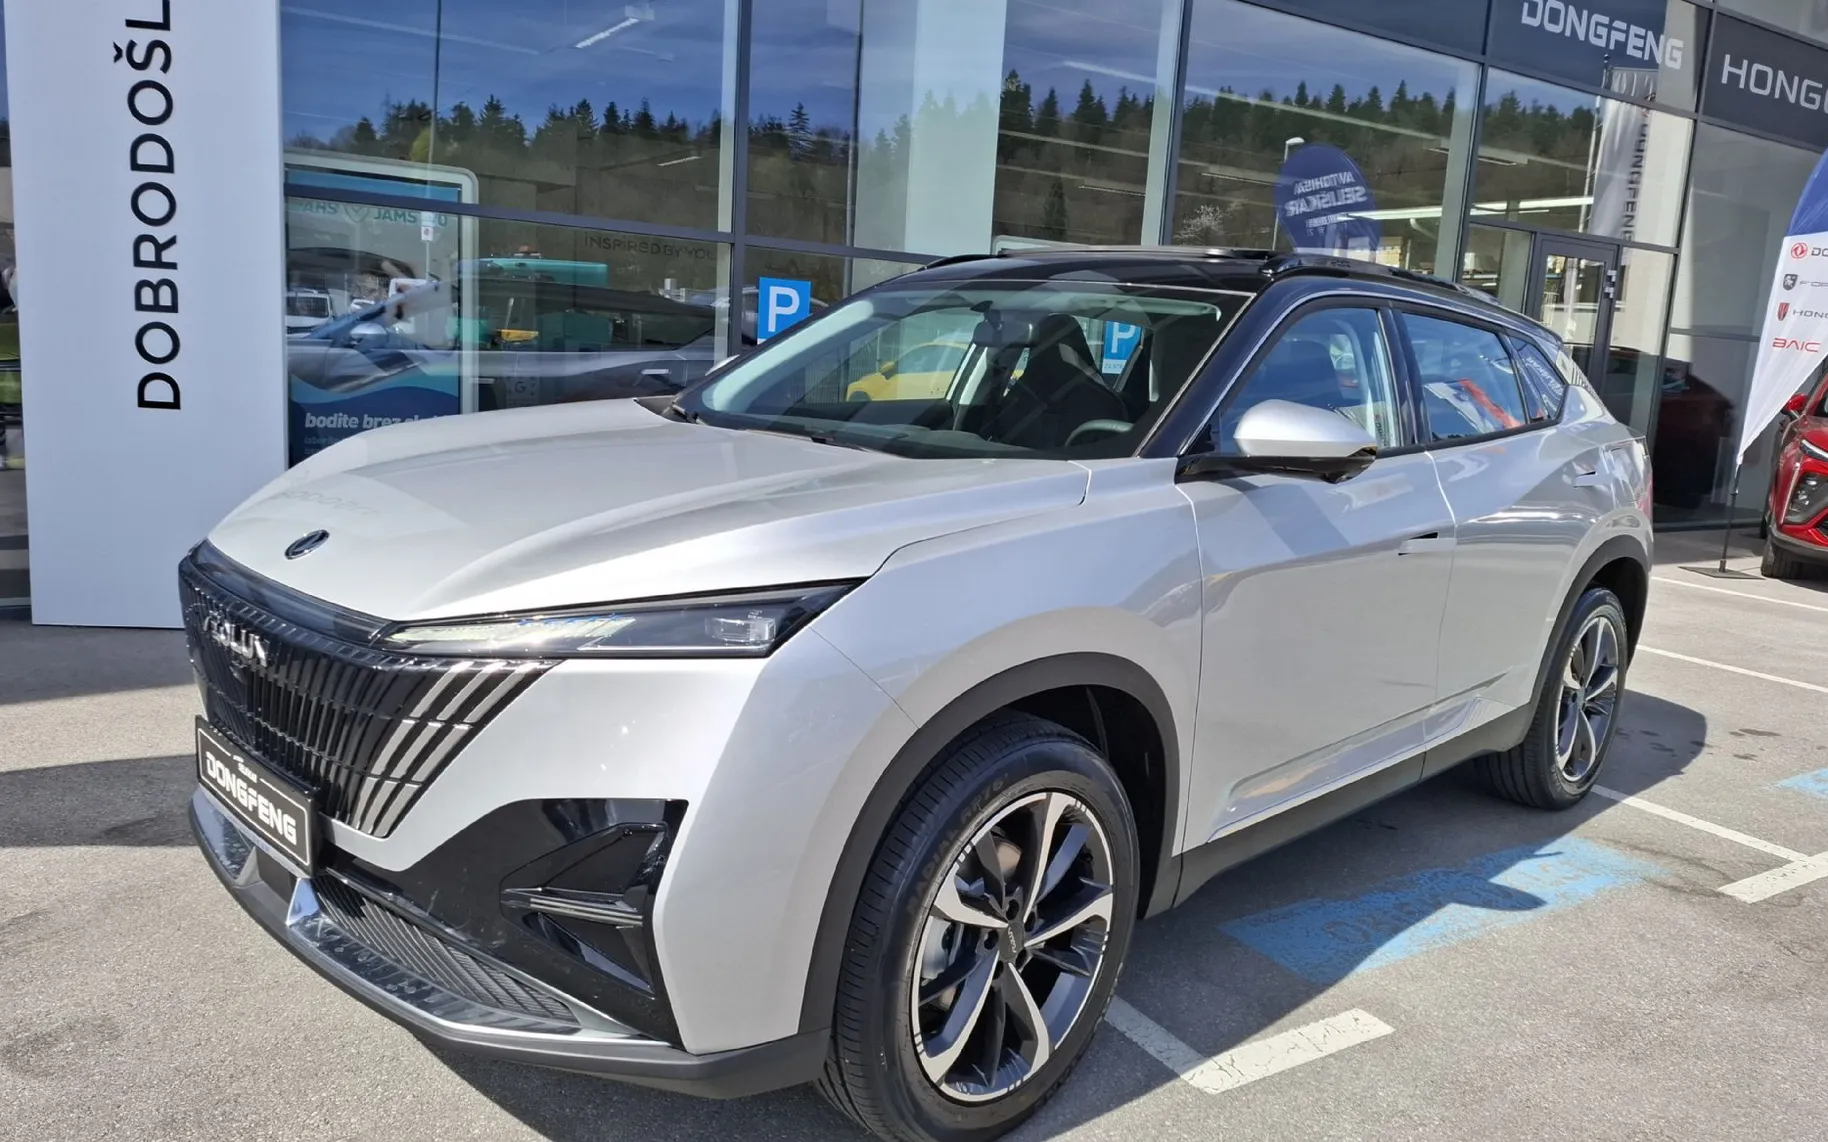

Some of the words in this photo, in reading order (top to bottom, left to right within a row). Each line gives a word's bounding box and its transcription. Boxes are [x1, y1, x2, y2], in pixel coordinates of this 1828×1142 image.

[1521, 0, 1684, 70] DONGFENG
[1721, 54, 1828, 114] HONG
[768, 286, 800, 332] P
[1772, 337, 1820, 352] BAIC
[305, 412, 359, 429] bodite
[205, 751, 297, 845] DONGFENG
